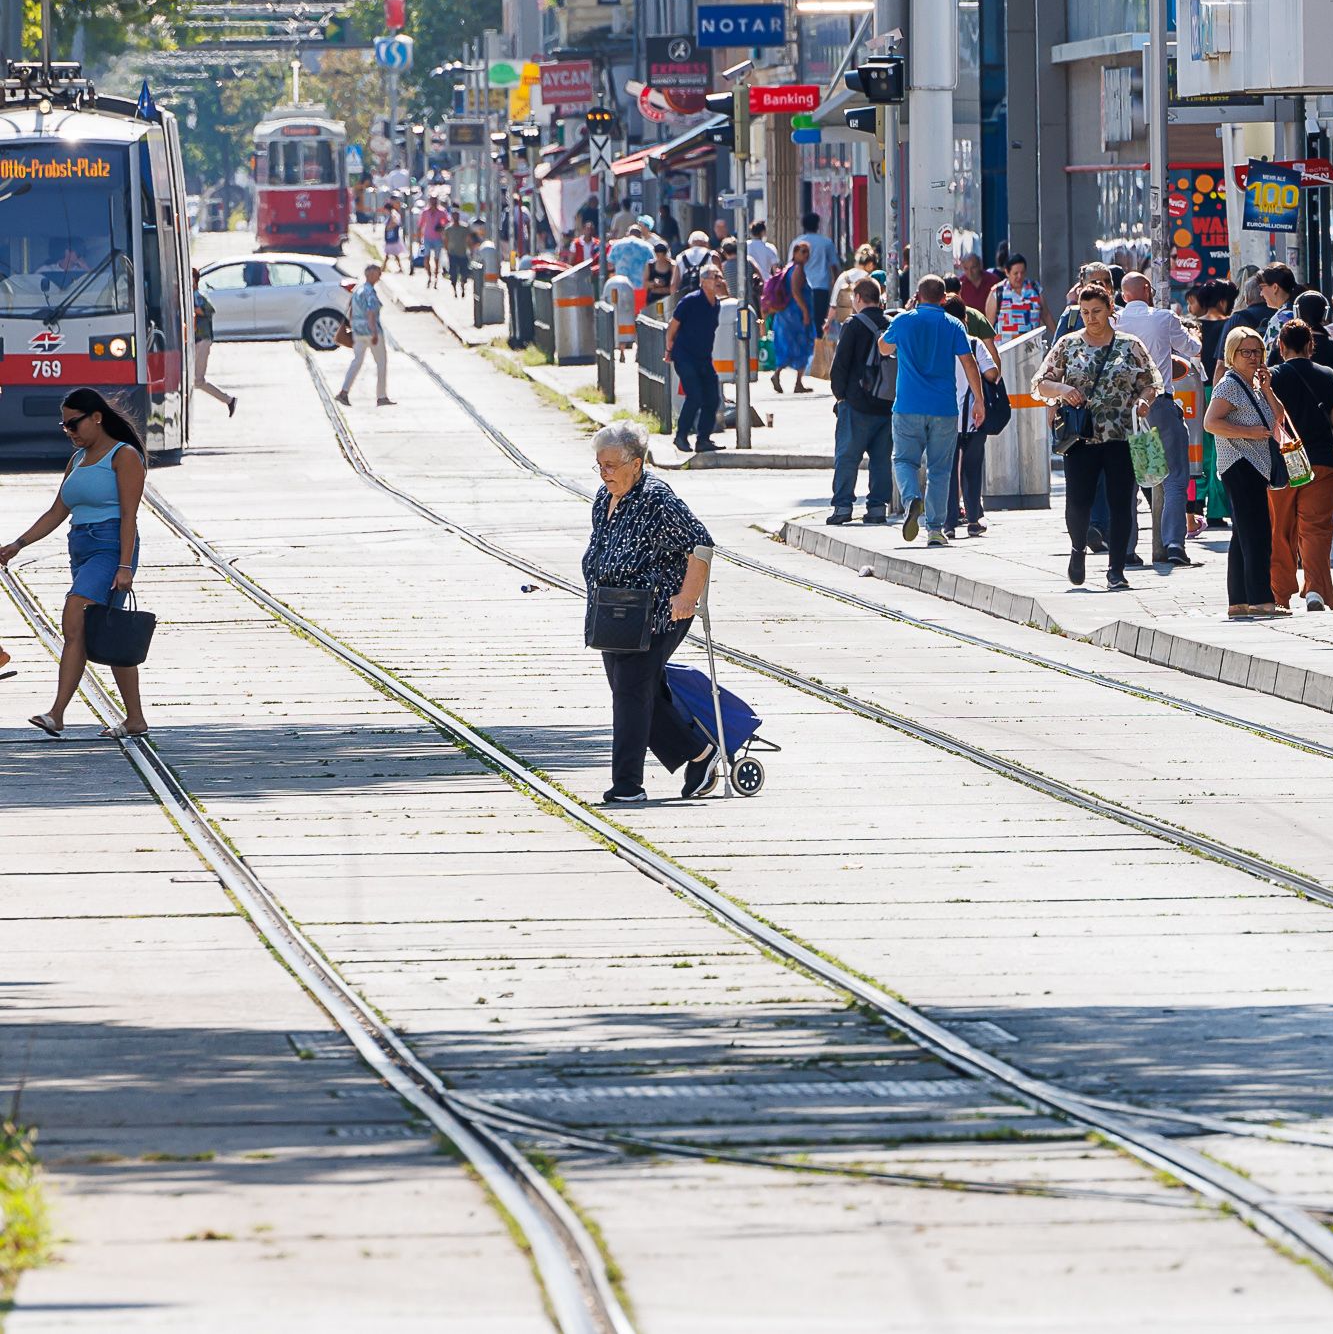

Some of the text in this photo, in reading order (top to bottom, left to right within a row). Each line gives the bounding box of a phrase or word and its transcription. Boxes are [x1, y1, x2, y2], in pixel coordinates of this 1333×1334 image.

[702, 17, 783, 33] NOTAR
[763, 90, 814, 109] Banking
[0, 157, 110, 179] Otto-Probst-Platz
[1247, 182, 1299, 209] 100
[1246, 221, 1293, 230] EUROMILLIONEN
[31, 360, 62, 378] 769
